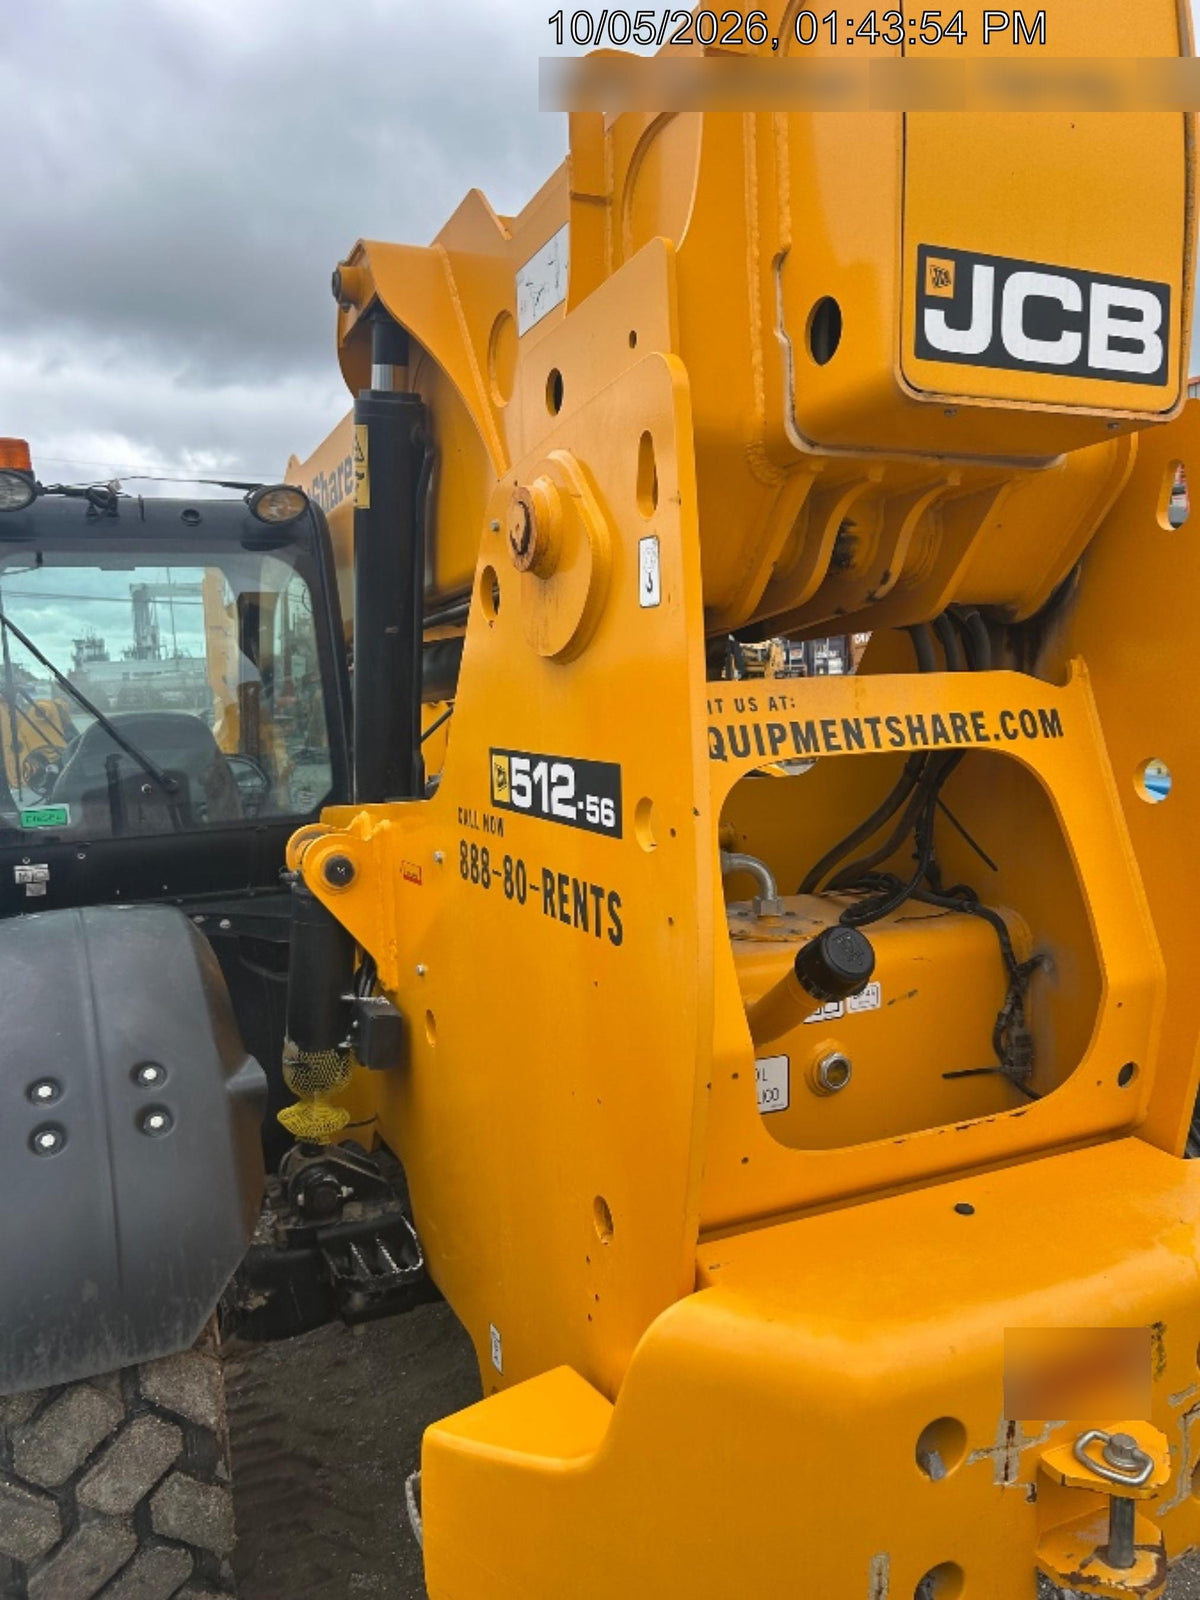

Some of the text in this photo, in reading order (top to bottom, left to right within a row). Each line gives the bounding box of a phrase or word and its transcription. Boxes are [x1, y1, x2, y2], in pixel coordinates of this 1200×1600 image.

[924, 264, 1164, 374] JCB
[734, 696, 759, 713] US
[768, 695, 796, 712] AT:
[707, 708, 1064, 762] QUIPMENTSHARE.COM
[457, 806, 505, 838] CALL NOW
[459, 838, 624, 947] 888-80-RENTS
